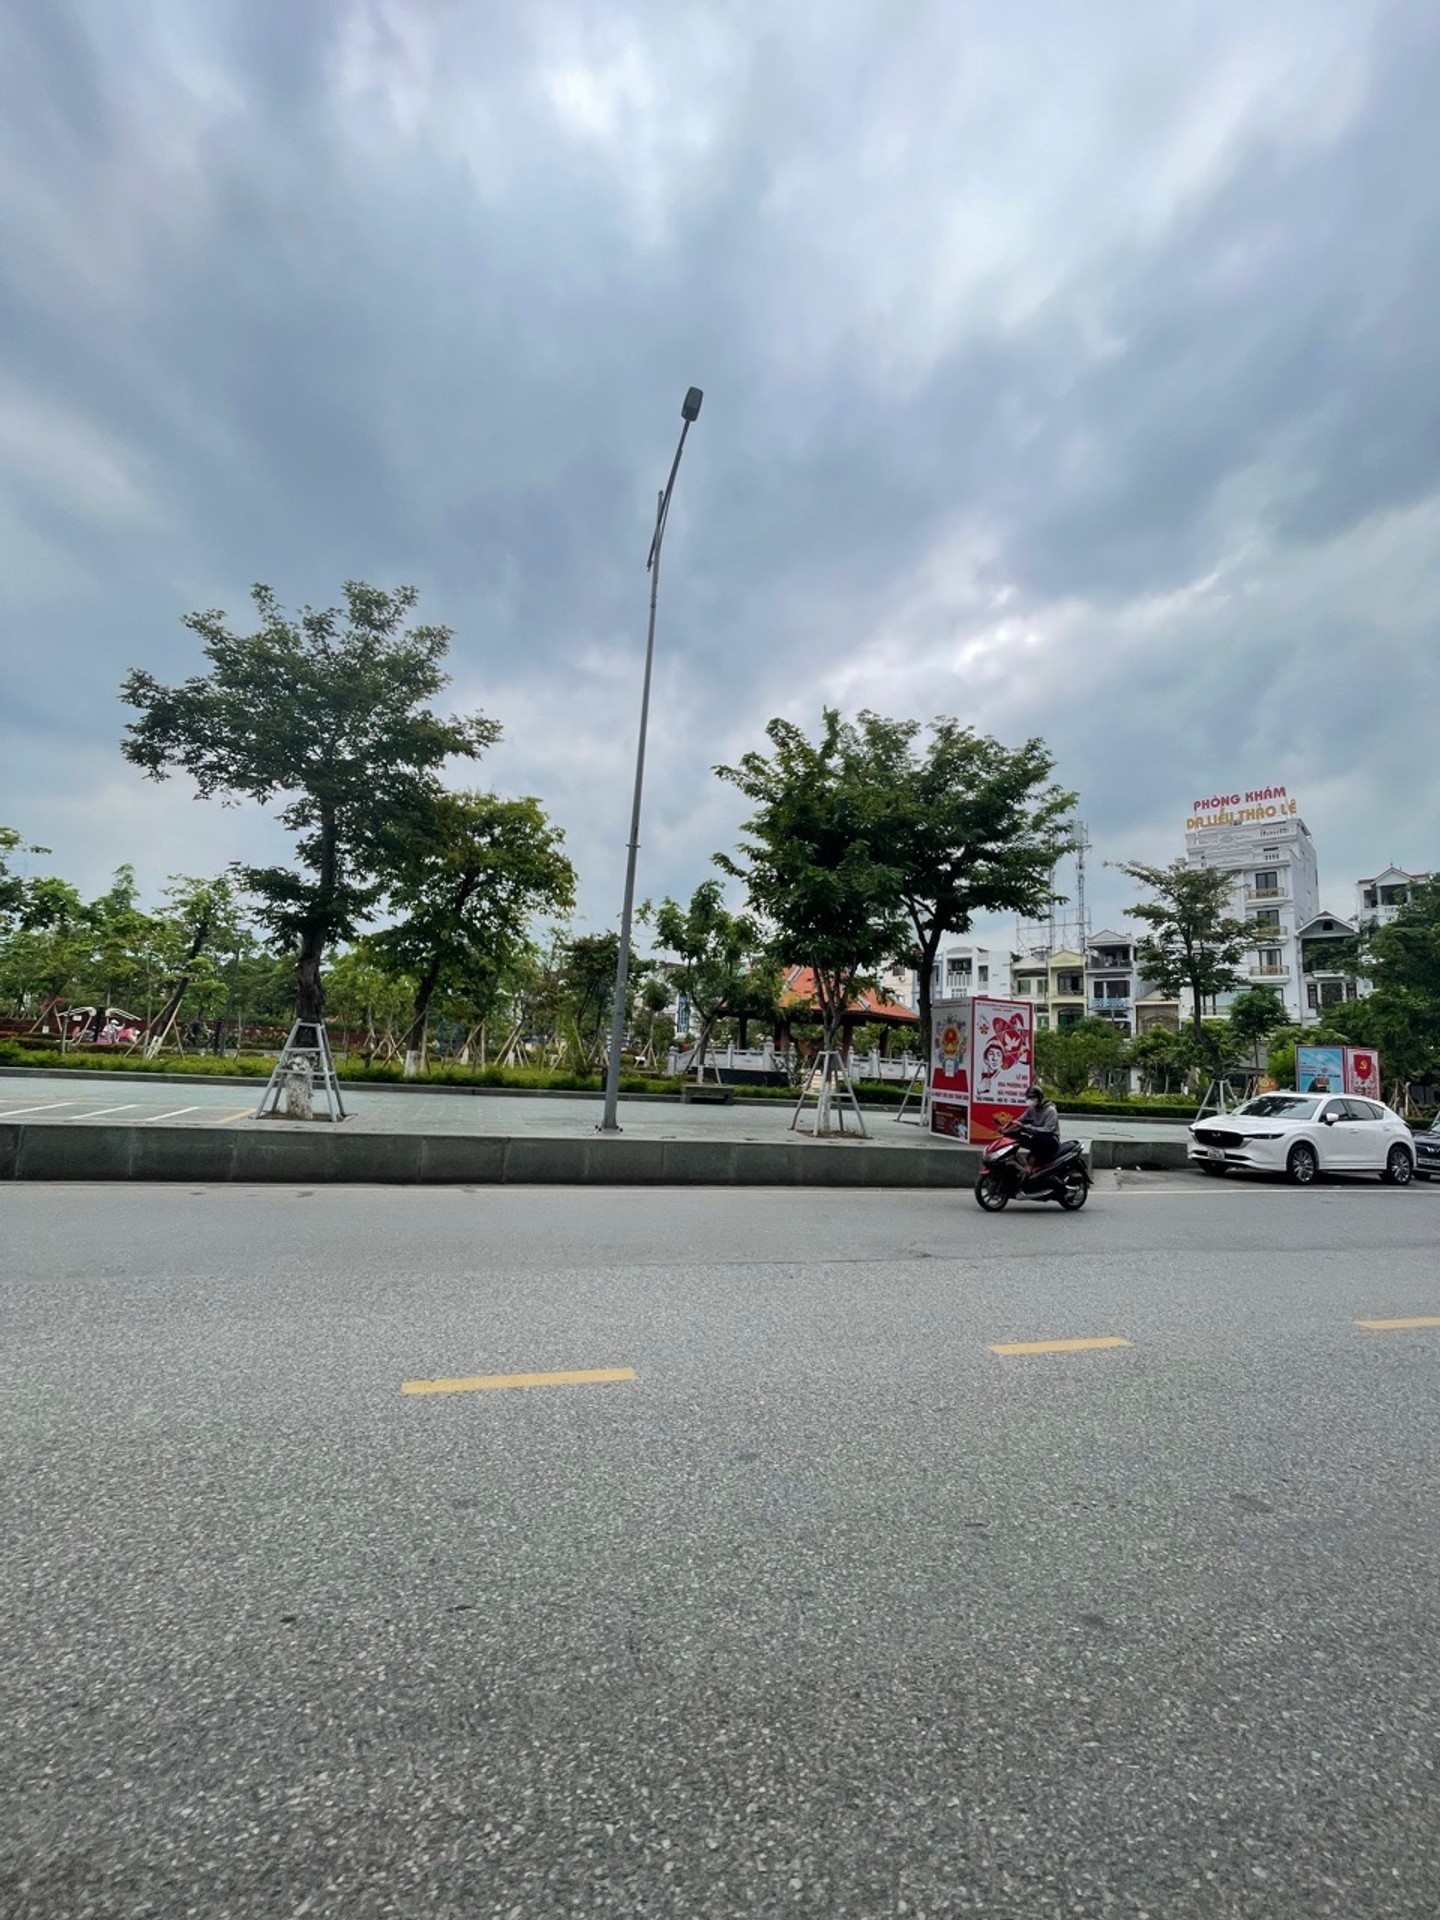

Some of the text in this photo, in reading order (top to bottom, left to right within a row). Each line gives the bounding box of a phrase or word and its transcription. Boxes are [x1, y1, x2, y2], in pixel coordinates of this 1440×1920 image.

[1194, 786, 1286, 811] PHÒNG KHÁM
[1186, 816, 1204, 829] DA
[1238, 803, 1277, 821] THẢO
